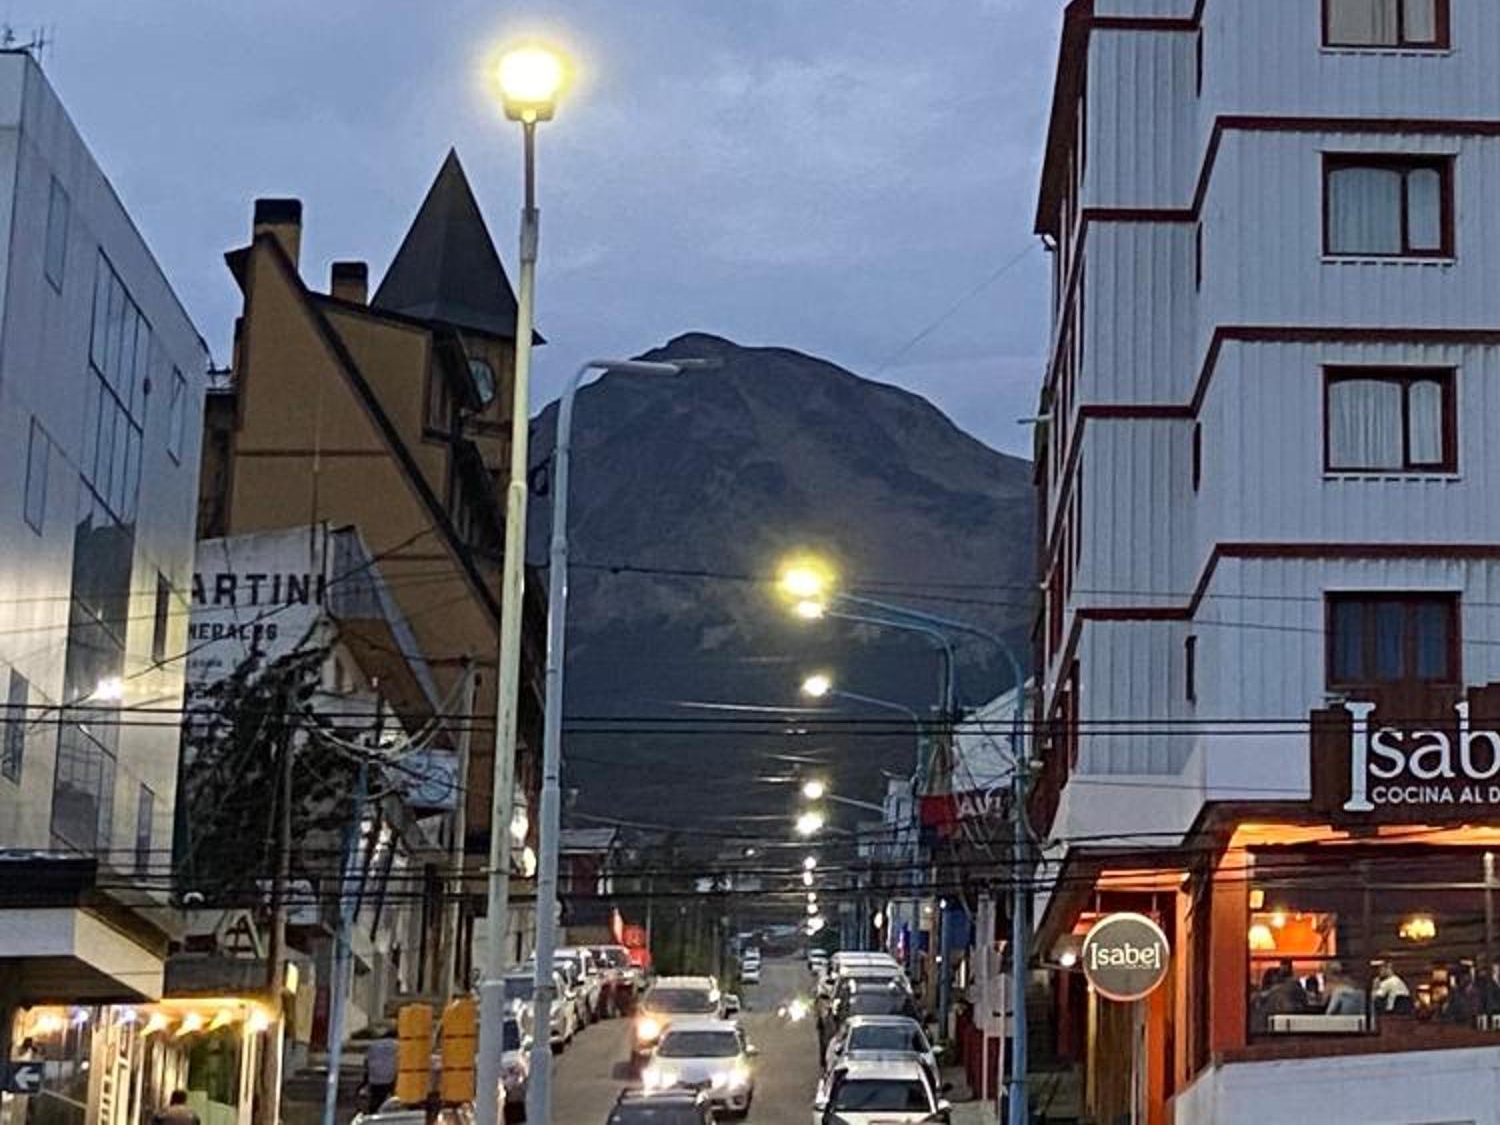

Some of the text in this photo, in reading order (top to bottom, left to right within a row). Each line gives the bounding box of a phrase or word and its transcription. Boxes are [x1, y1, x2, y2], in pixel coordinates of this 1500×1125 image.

[1372, 785, 1454, 804] COCINA
[1459, 785, 1485, 804] AL
[1090, 942, 1161, 971] Isabel
